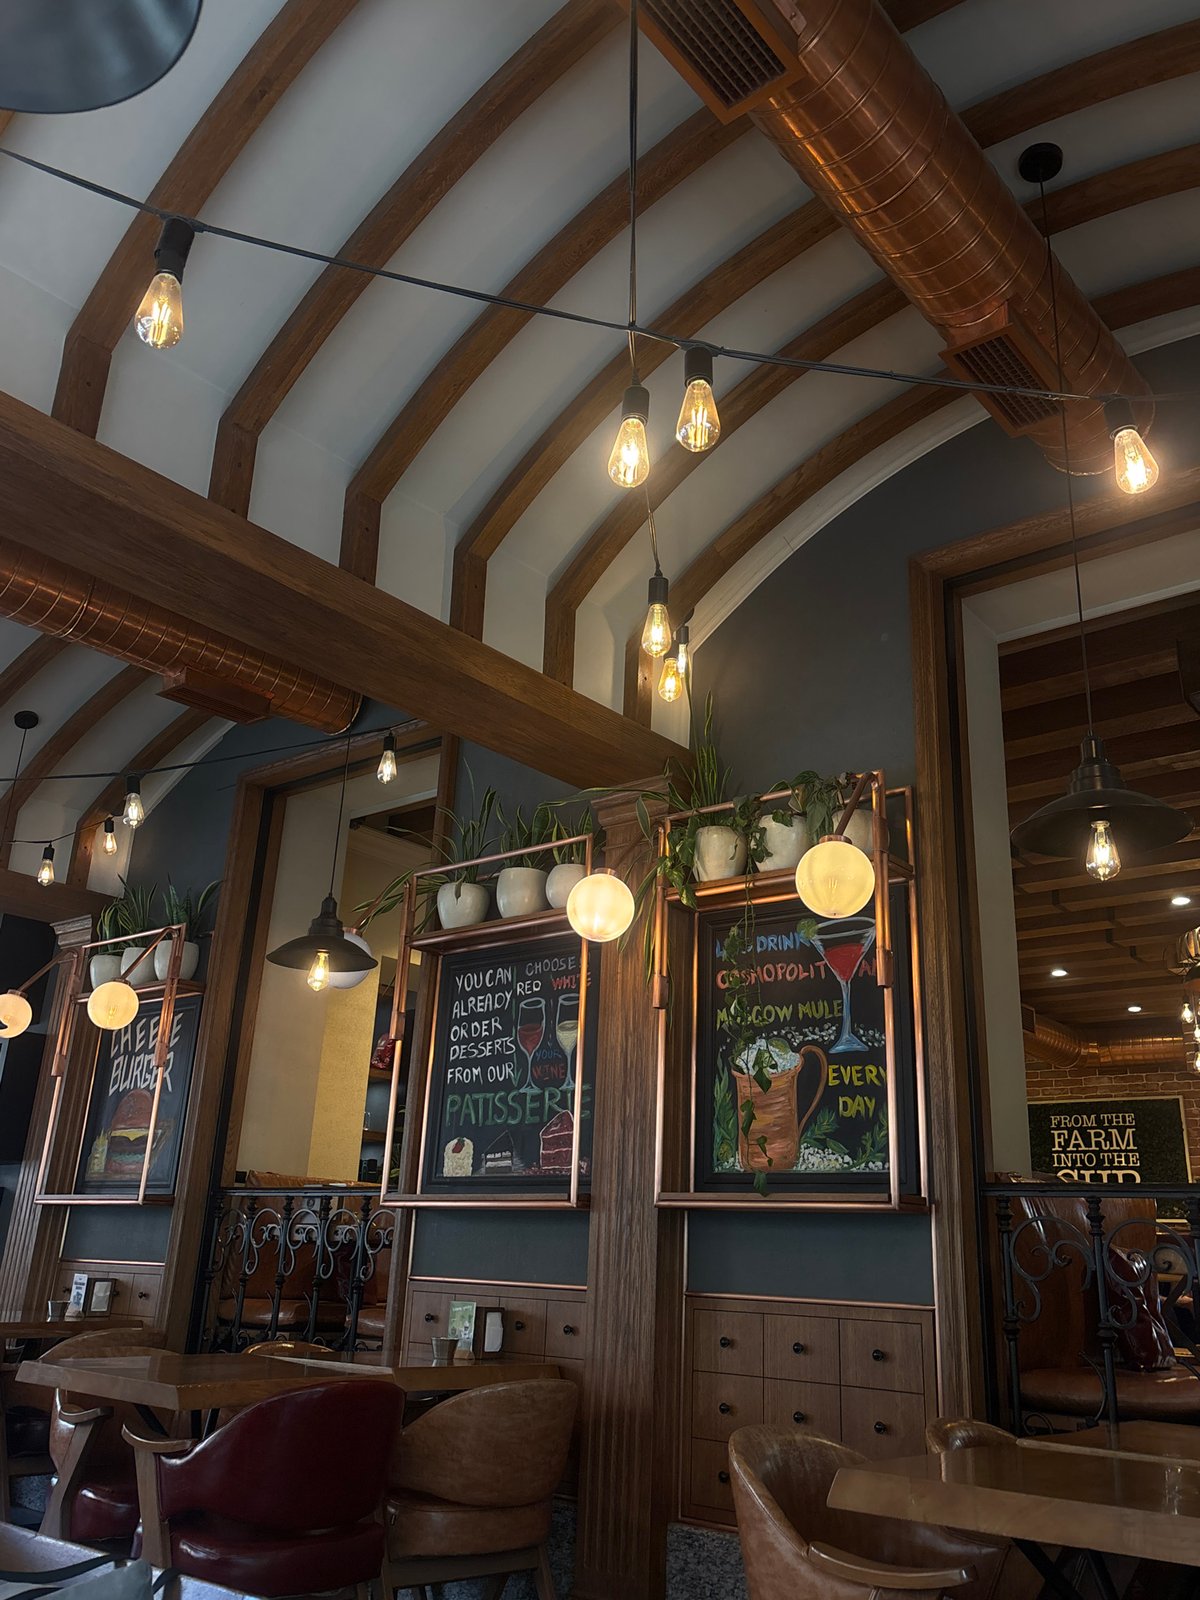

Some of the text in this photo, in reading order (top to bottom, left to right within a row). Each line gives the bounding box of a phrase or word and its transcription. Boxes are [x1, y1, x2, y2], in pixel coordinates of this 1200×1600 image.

[526, 956, 576, 976] CHOOSE
[455, 965, 512, 993] YOU CAN
[516, 980, 542, 996] RED
[452, 989, 513, 1019] ALREADY
[798, 999, 844, 1021] MULE
[110, 1012, 184, 1059] CHEEE
[450, 1017, 502, 1042] ORDER
[449, 1037, 516, 1061] DESSERTS
[536, 1050, 562, 1061] YOUR
[447, 1062, 515, 1085] FROM OUR
[532, 1063, 566, 1081] WINE
[838, 1094, 876, 1119] DAY
[1050, 1112, 1136, 1128] FROM THE
[1050, 1128, 1138, 1151] FARM
[1052, 1152, 1140, 1167] INTO THE
